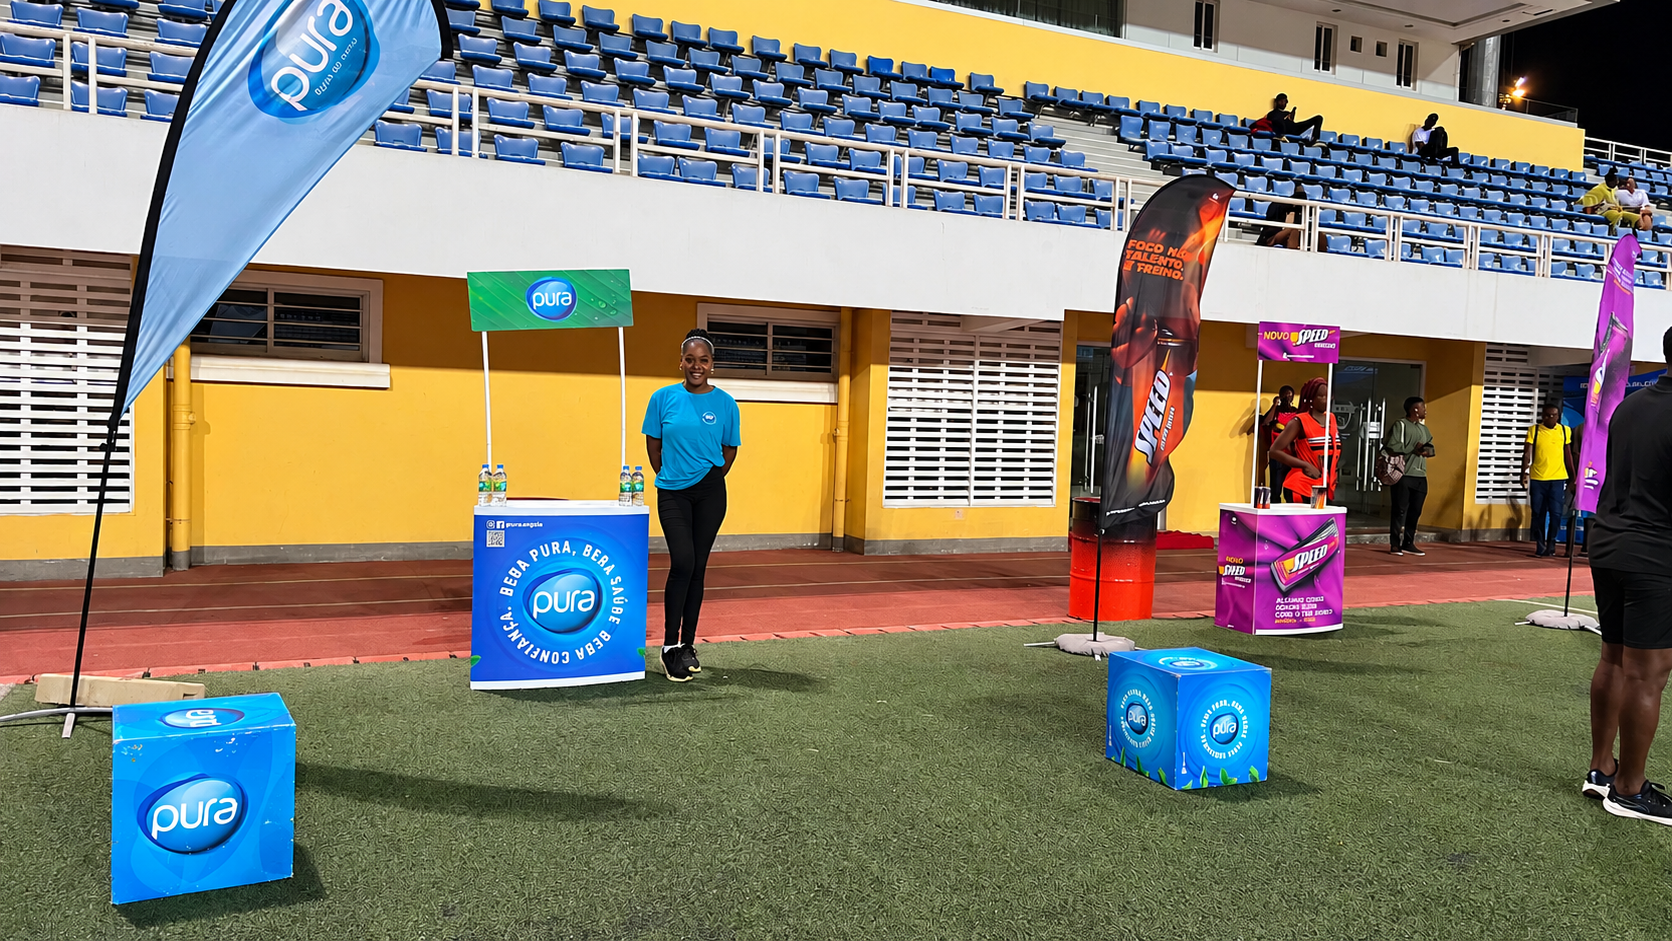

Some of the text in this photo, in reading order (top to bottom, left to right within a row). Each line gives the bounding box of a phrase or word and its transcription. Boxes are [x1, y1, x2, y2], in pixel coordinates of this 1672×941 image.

[271, 0, 353, 111] pura
[1127, 239, 1164, 253] FOCO
[532, 291, 572, 310] pura
[1263, 331, 1289, 340] NOVO
[1293, 329, 1329, 346] SPEED
[1134, 369, 1170, 464] SPEED
[529, 540, 576, 562] PURA,
[1289, 543, 1328, 574] SPEED
[532, 589, 595, 619] pura
[1127, 709, 1146, 727] pura
[1213, 721, 1237, 739] pura
[151, 797, 238, 840] pura
